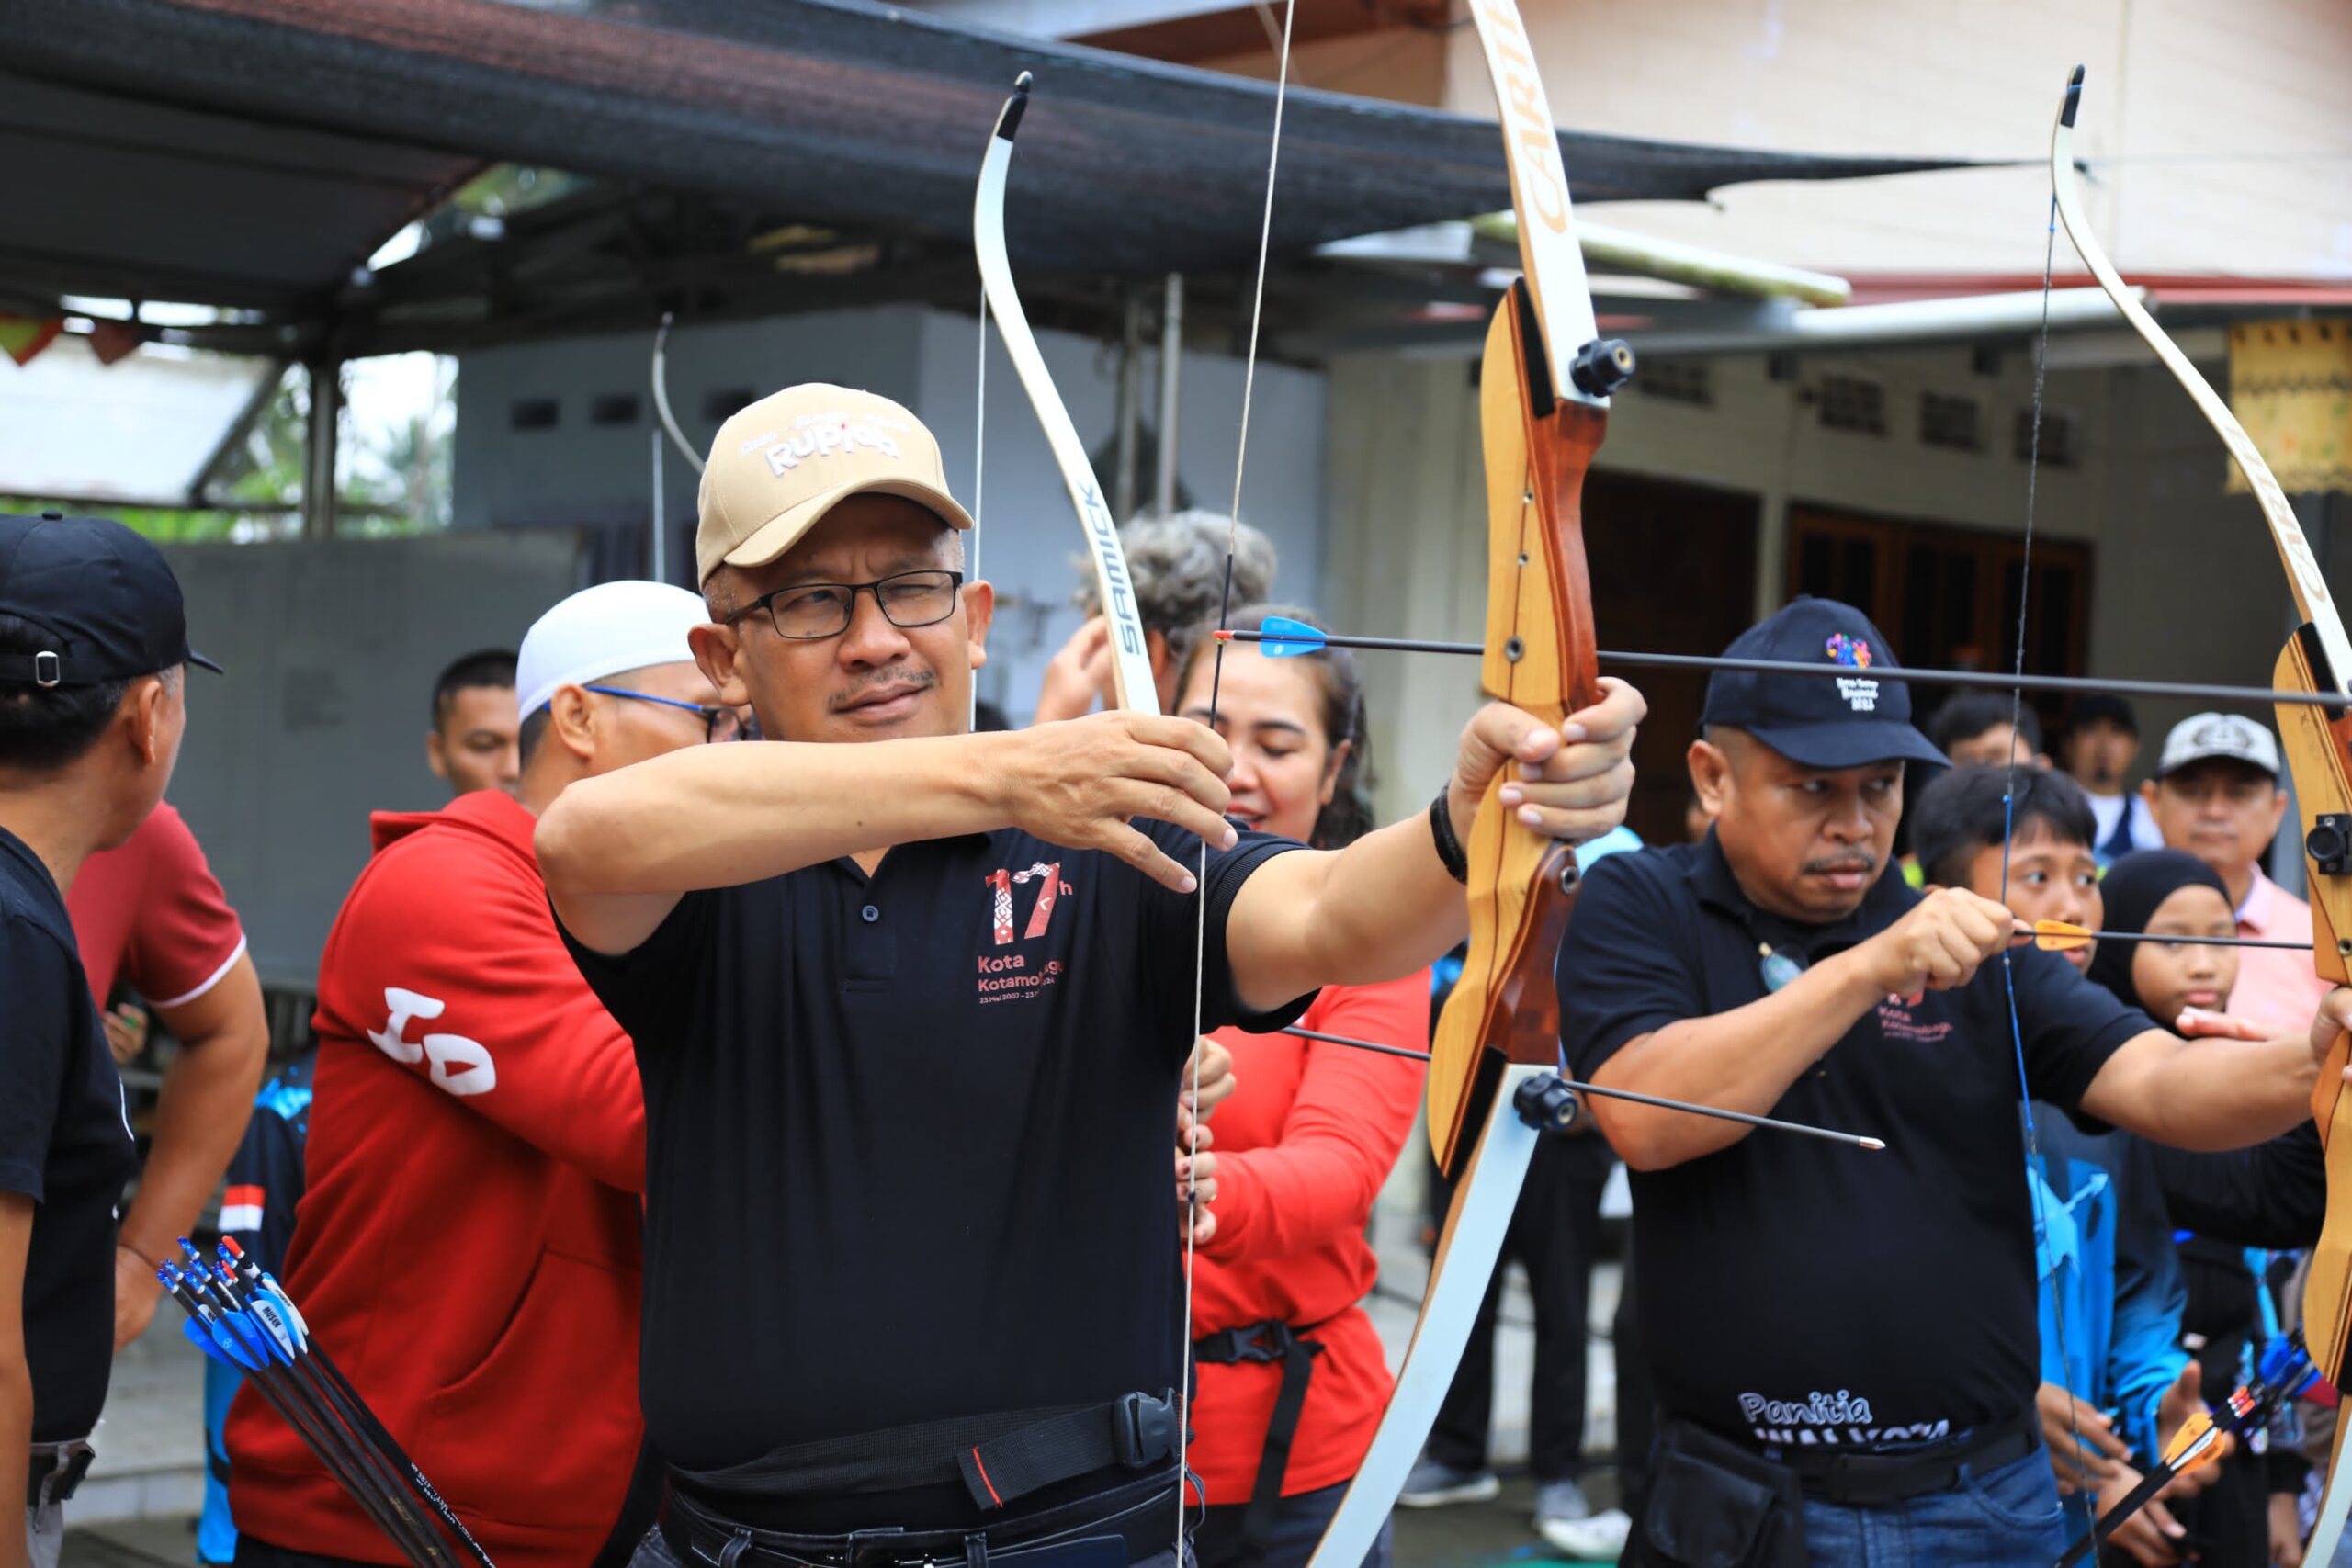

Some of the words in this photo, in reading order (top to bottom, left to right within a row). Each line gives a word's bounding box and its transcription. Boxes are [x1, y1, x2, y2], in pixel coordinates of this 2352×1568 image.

[1077, 479, 1141, 656] SAMICK
[978, 955, 1025, 974] Kota
[1002, 992, 1020, 1000] 2007
[1738, 1389, 1873, 1425] Panitia
